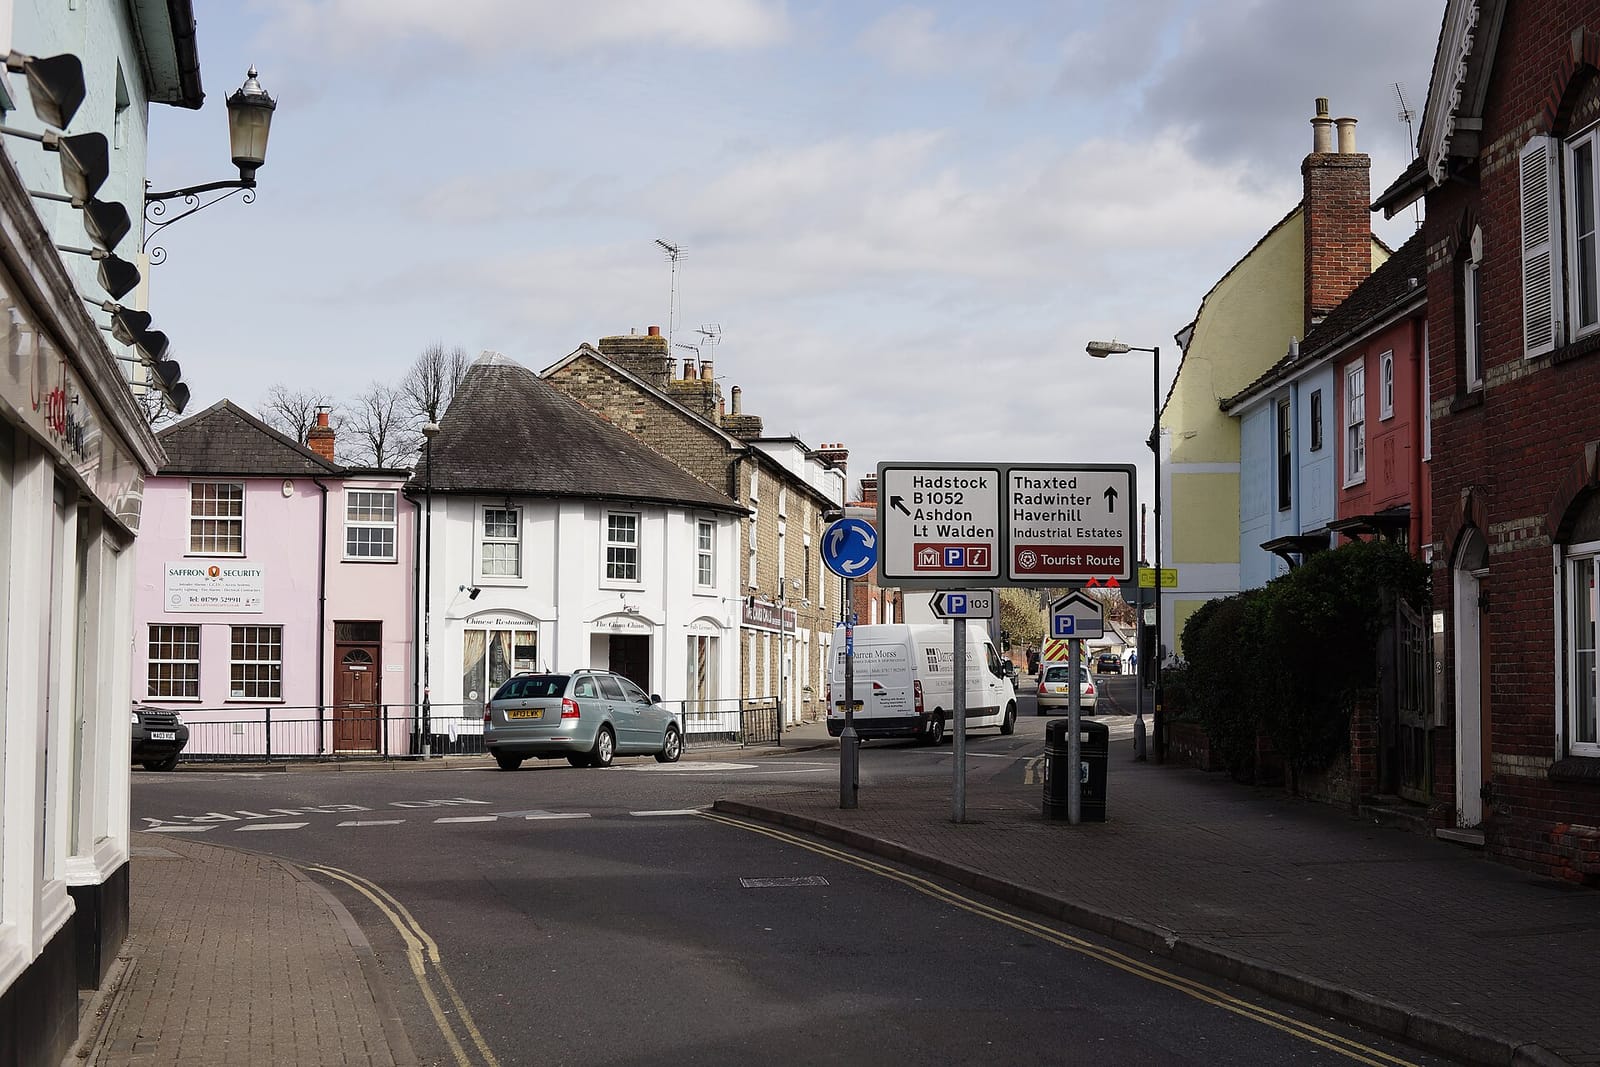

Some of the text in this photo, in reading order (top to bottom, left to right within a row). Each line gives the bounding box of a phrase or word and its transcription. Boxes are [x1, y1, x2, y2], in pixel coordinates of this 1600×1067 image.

[913, 475, 988, 489] Hadstock
[1013, 476, 1077, 489] Thaxted
[1013, 492, 1092, 506] Radwinter
[913, 508, 973, 521] Ashdon
[1013, 508, 1082, 522] Haverhill
[913, 524, 995, 538] Lt Walden
[1013, 527, 1123, 538] Industrial Estates
[948, 550, 960, 564] P
[1040, 554, 1121, 566] Tourist Route
[168, 568, 262, 577] SAFFRON SECURITY
[951, 596, 989, 612] P 103
[495, 618, 534, 626] Restaurant
[1059, 617, 1072, 633] P
[874, 649, 897, 659] Morss
